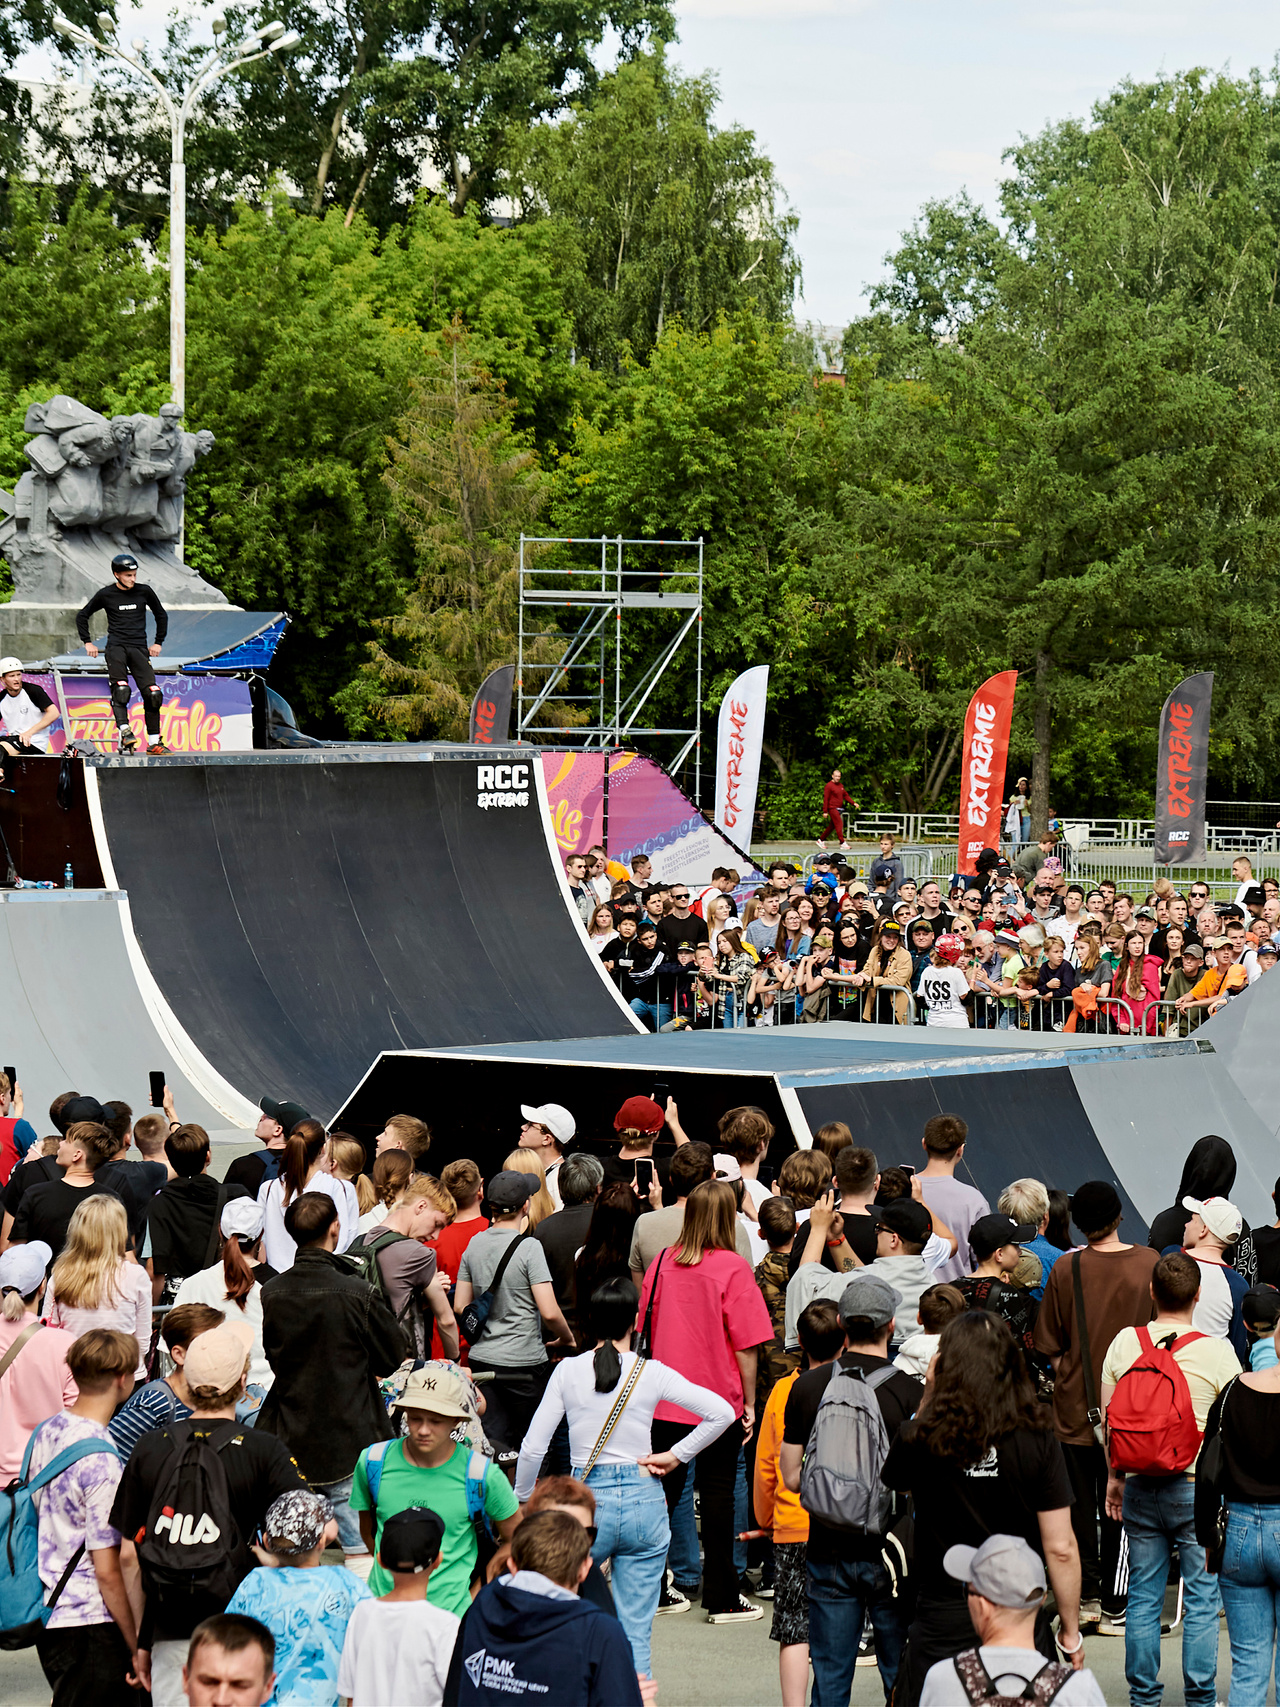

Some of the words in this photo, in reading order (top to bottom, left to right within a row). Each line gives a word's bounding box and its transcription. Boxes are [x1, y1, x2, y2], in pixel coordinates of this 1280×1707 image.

[724, 699, 748, 828] EXTREME
[968, 701, 996, 828] EXTREME
[1167, 701, 1194, 818] EXTREME
[477, 765, 529, 790] RCC
[477, 791, 530, 810] EXTREME
[967, 841, 984, 852] RCC
[1168, 831, 1190, 841] RCC
[924, 980, 951, 1000] KSS
[154, 1505, 220, 1545] FILA
